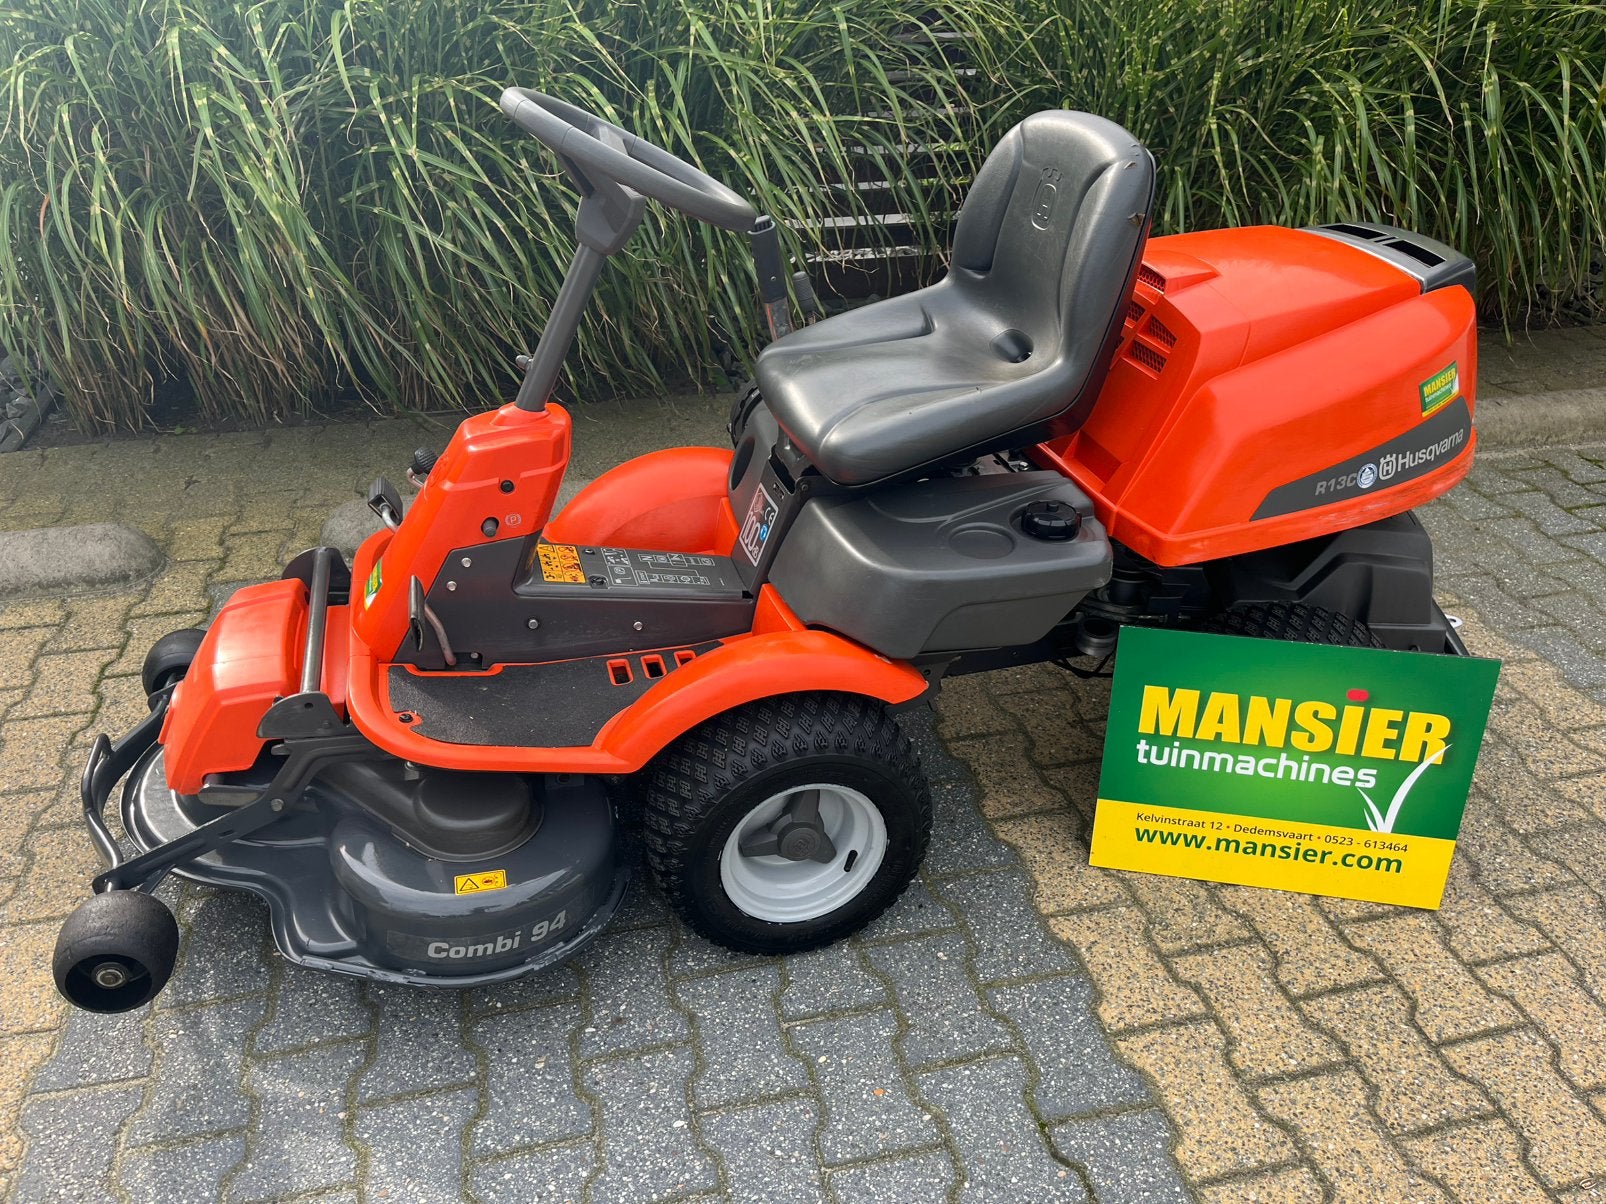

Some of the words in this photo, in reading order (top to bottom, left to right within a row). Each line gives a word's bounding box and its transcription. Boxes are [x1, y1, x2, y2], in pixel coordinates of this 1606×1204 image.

[1398, 429, 1463, 472] Husqvarna
[1136, 739, 1378, 789] tuinmachines
[1135, 827, 1403, 873] www.mansier.com
[1136, 812, 1206, 829] Kelvinstraat
[1209, 821, 1223, 831] 12
[1233, 823, 1314, 842] Dedemsvaart
[1324, 834, 1354, 846] 0523
[1363, 839, 1408, 853] 613464
[427, 931, 522, 959] Combi
[530, 910, 567, 942] 94
